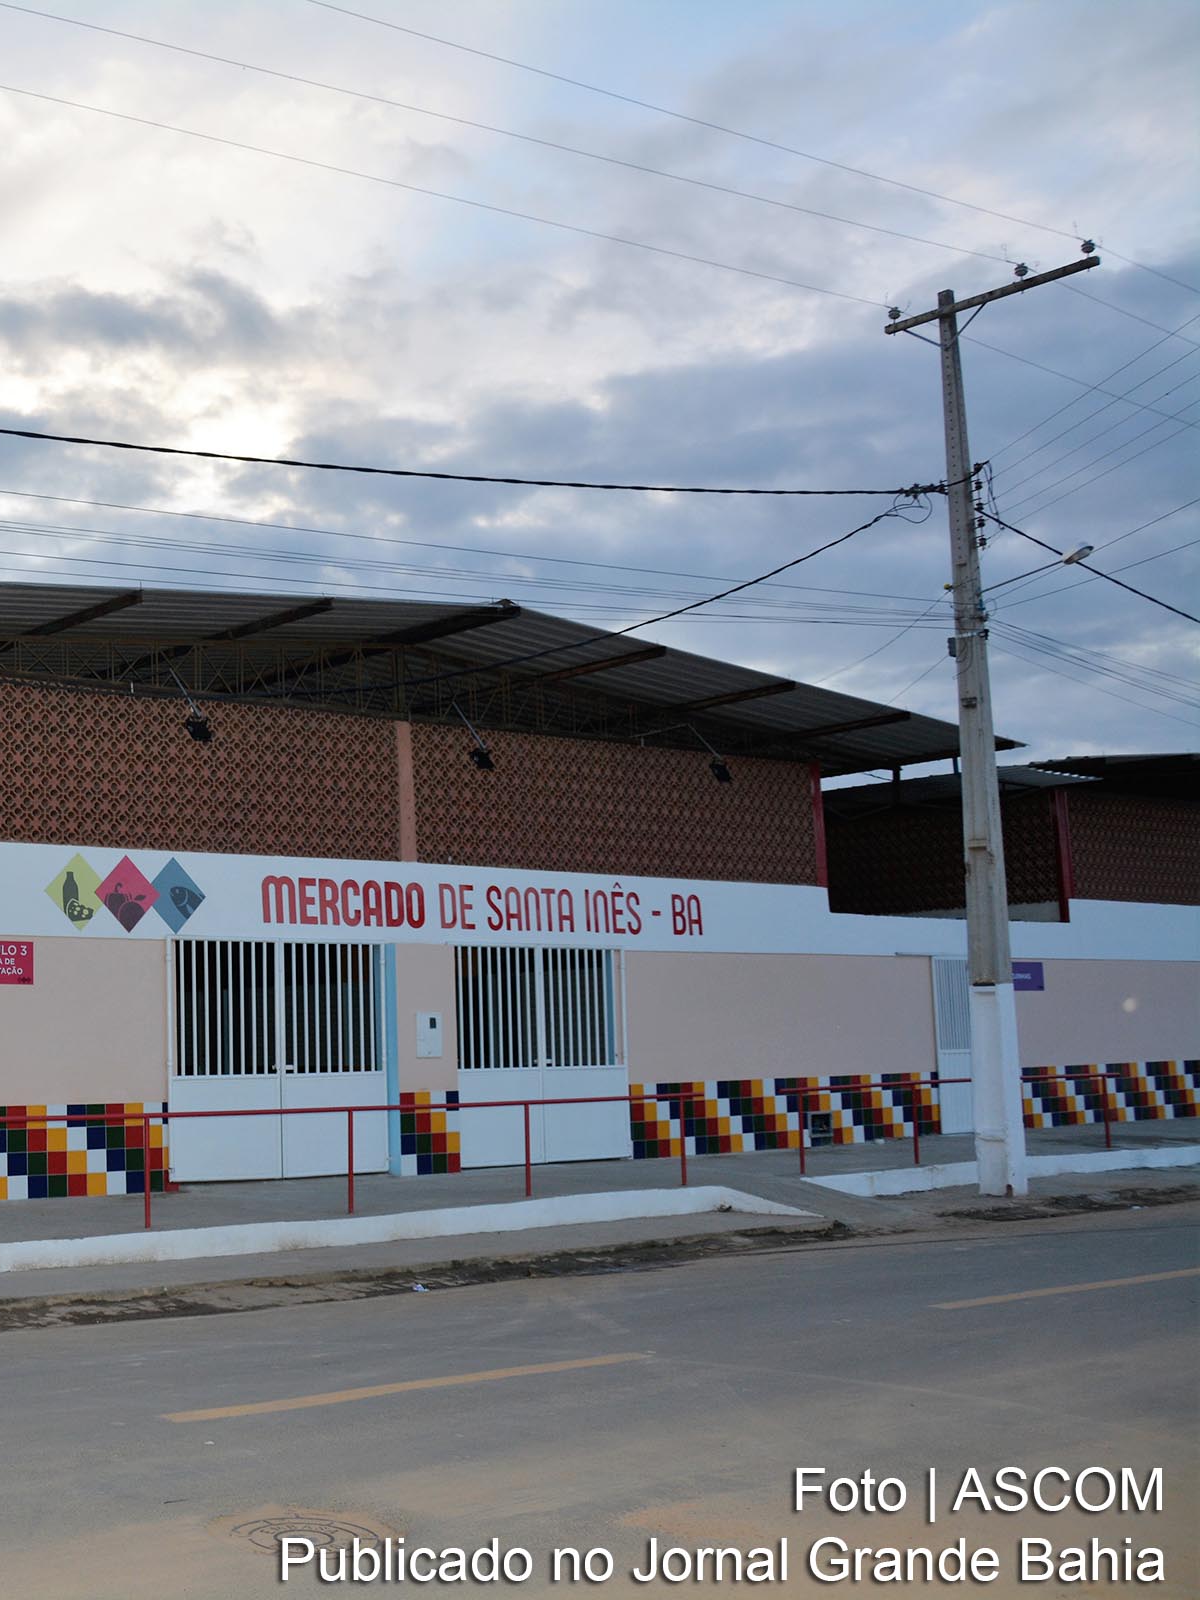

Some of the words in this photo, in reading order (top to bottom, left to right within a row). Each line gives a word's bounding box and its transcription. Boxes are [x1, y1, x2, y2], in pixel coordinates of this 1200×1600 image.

[262, 875, 426, 929] MERCADO
[439, 883, 476, 930] DE
[485, 885, 575, 932] SANTA
[585, 882, 642, 935] INÊS
[672, 894, 704, 936] BA
[20, 945, 28, 956] 3
